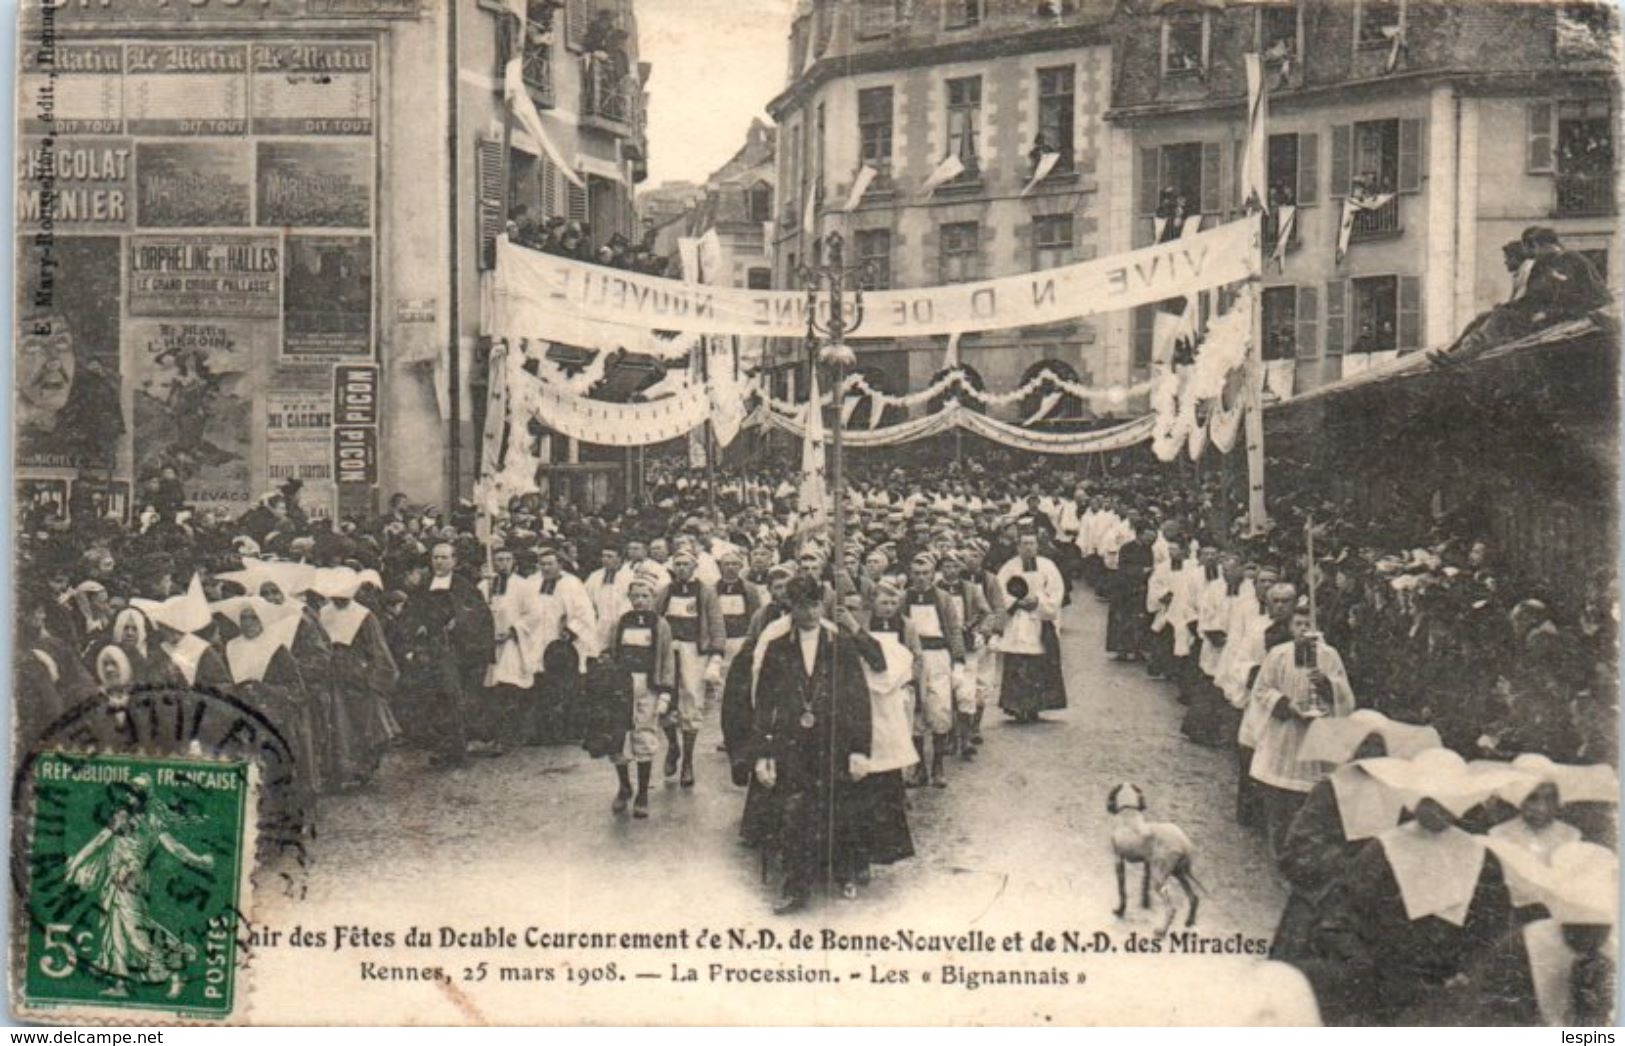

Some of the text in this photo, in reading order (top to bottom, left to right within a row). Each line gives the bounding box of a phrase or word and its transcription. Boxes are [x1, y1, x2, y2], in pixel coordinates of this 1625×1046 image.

[129, 46, 243, 71] Le Matin
[290, 46, 369, 70] Matin
[209, 121, 244, 133] TOUT
[305, 120, 370, 133] DIT TOUT
[227, 246, 278, 273] HALLES
[345, 371, 373, 422] PICON
[340, 430, 366, 481] PICON
[204, 917, 230, 999] POSTES
